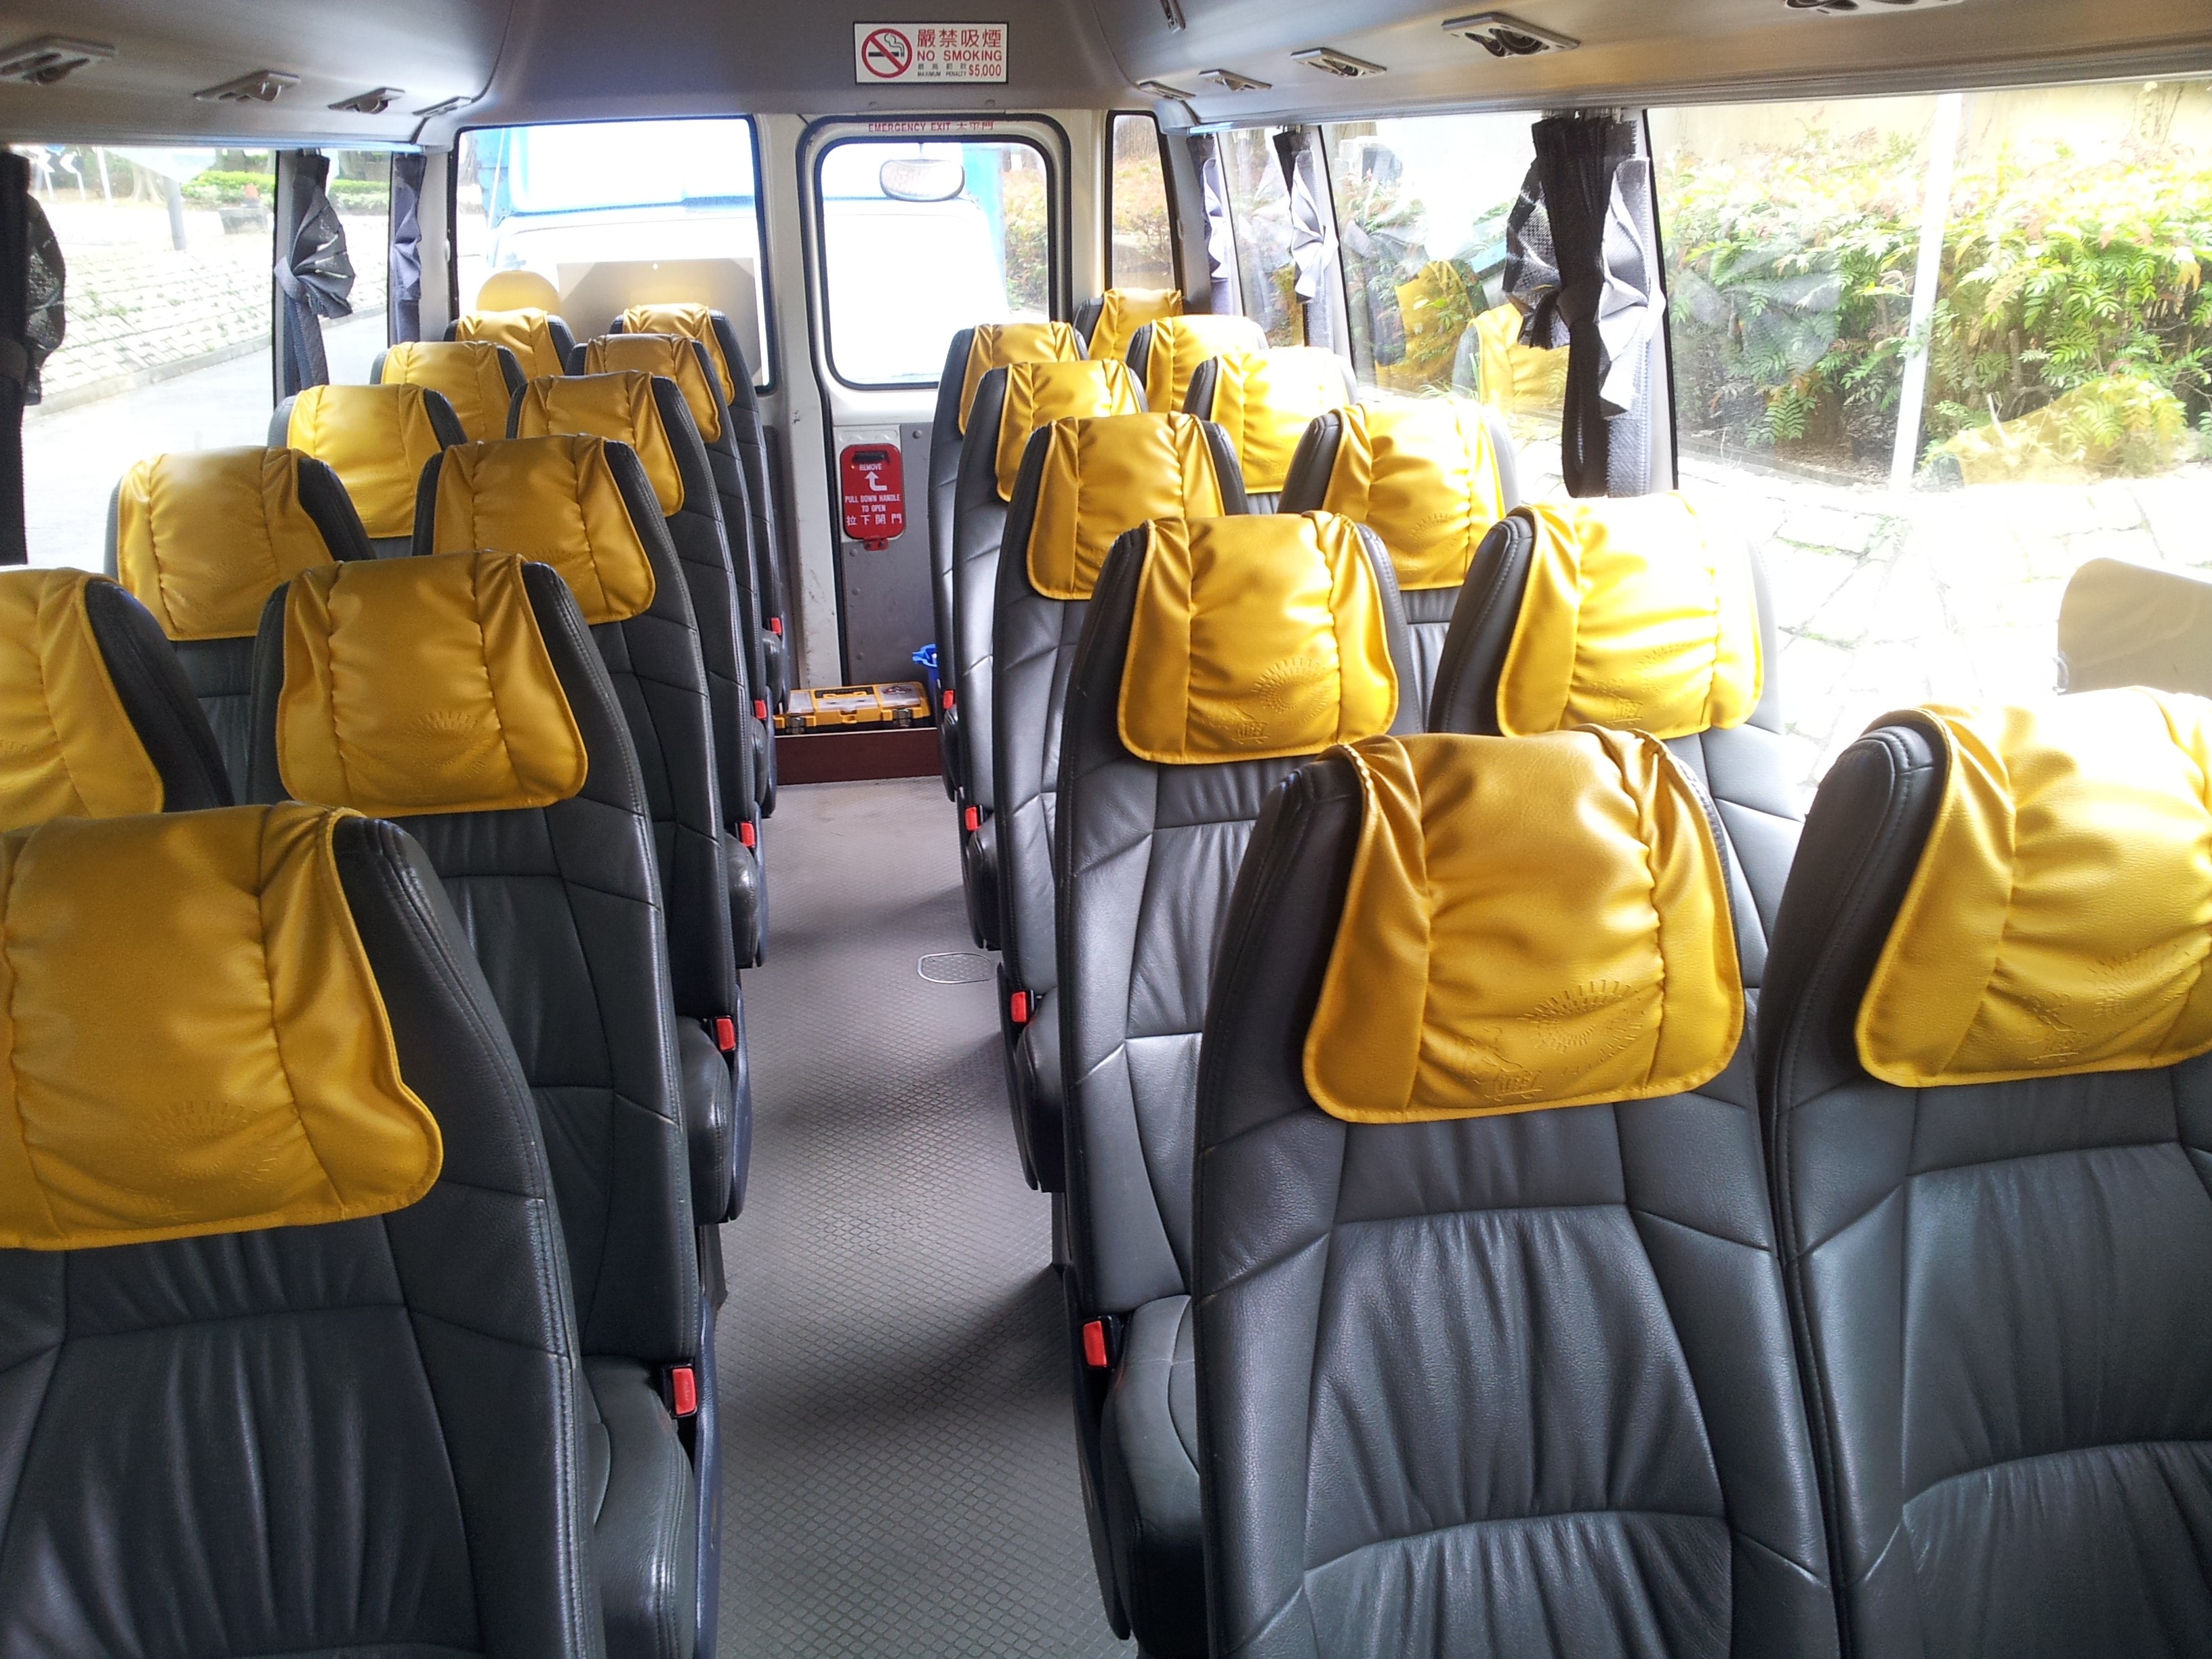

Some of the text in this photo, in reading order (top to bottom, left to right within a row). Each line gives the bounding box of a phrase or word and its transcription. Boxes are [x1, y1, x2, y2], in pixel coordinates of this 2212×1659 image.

[917, 28, 1002, 47] 嚴禁吸煙
[917, 50, 1002, 62] NO SMOKING
[968, 64, 1002, 77] $5,000
[868, 122, 951, 132] EMERGENCY EXIT
[859, 463, 882, 471] REMOVE
[844, 493, 901, 504] PULL DOWN HANDLE
[871, 504, 886, 512] OPEN
